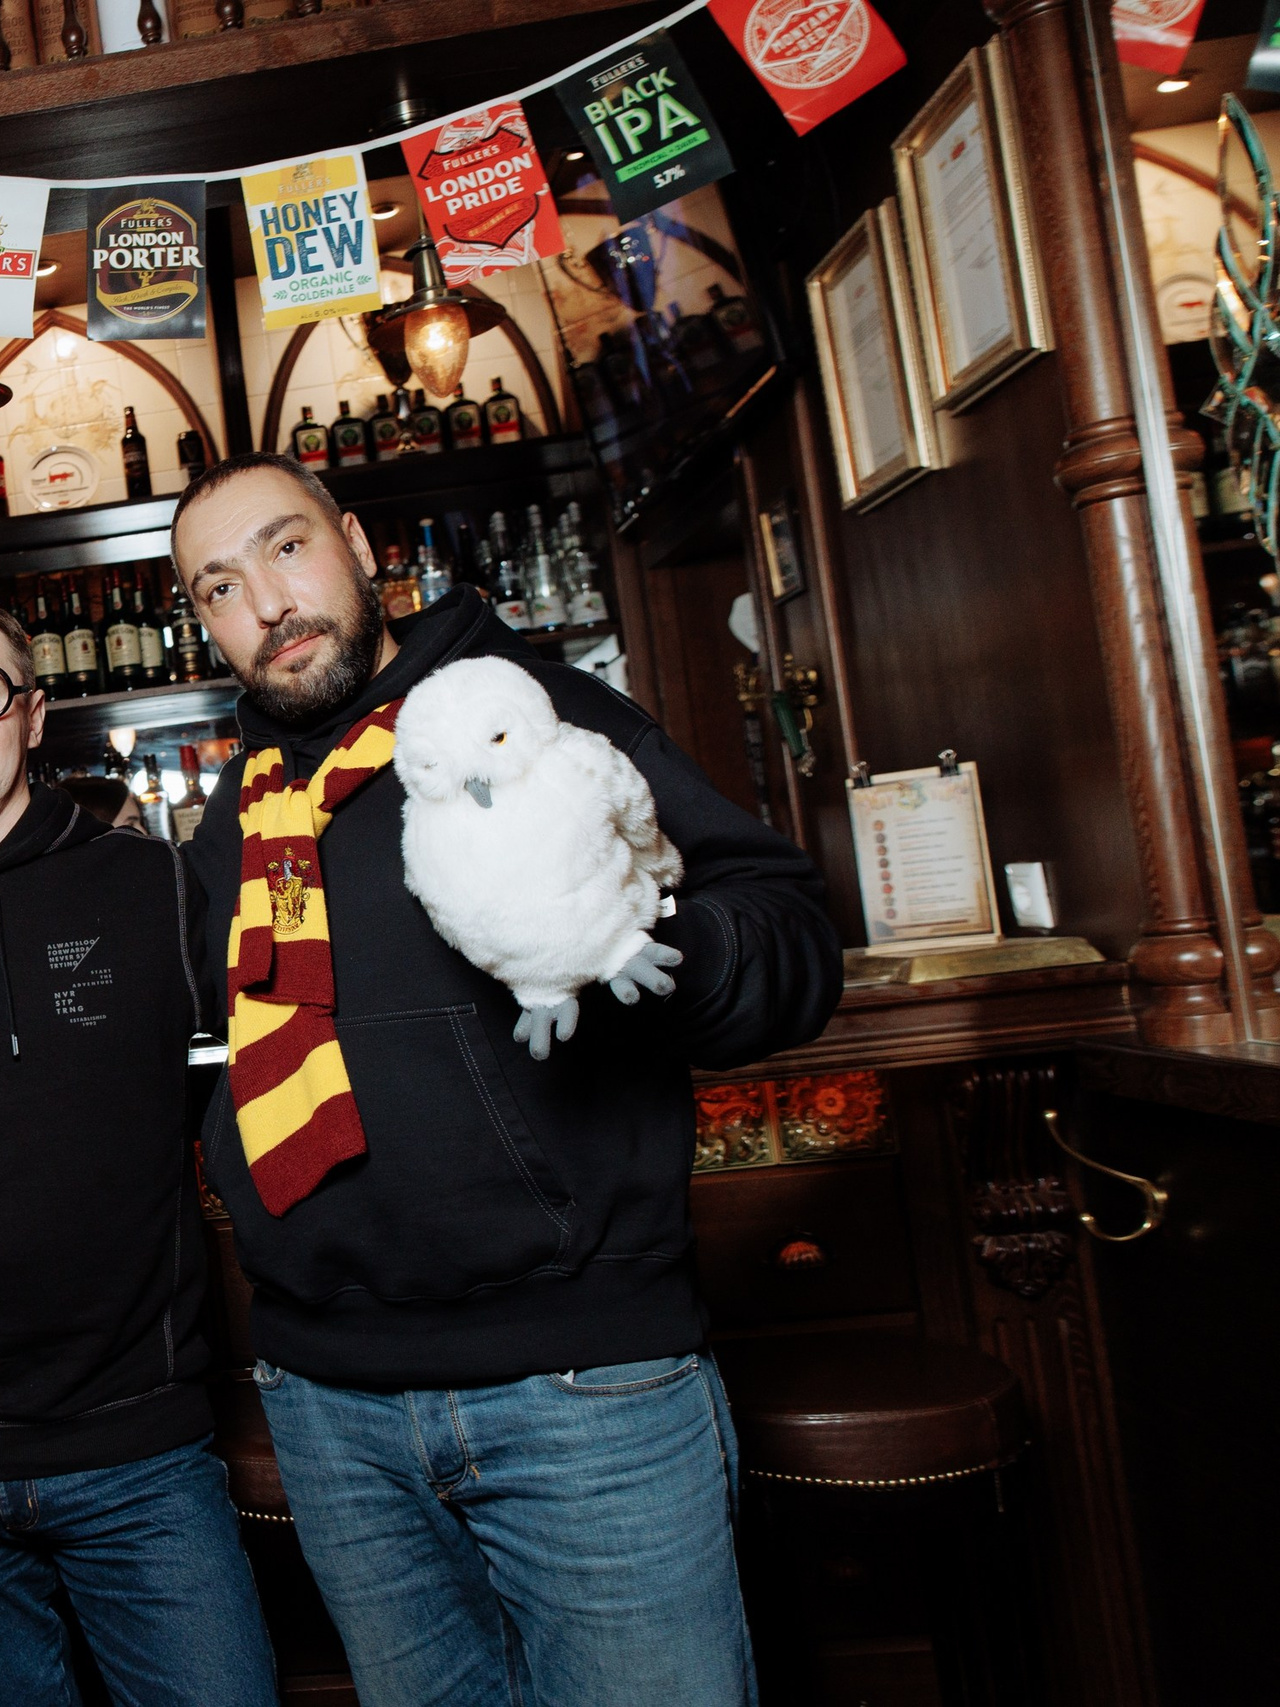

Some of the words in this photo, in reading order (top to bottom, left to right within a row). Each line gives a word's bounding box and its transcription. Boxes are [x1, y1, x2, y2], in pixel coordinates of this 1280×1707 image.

[771, 4, 841, 54] MONTANA
[583, 66, 677, 125] BLACK
[594, 92, 701, 165] IPA
[424, 152, 533, 203] LONDON
[445, 176, 525, 216] PRIDE
[120, 217, 173, 229] FULLER'S
[259, 190, 358, 237] HONEY
[108, 231, 184, 247] LONDON
[92, 245, 205, 270] PORTER
[265, 219, 364, 281] DEW
[288, 270, 354, 292] ORGANIC
[290, 288, 334, 303] GOLDEN
[336, 284, 356, 295] ALE
[48, 954, 74, 963] NEVER
[49, 960, 78, 970] TRYING
[72, 980, 114, 989] ADVENTURE
[54, 990, 76, 999] NVR
[55, 998, 73, 1007] STP
[56, 1005, 84, 1015] TRNG
[69, 1014, 107, 1023] ESTABLISHED
